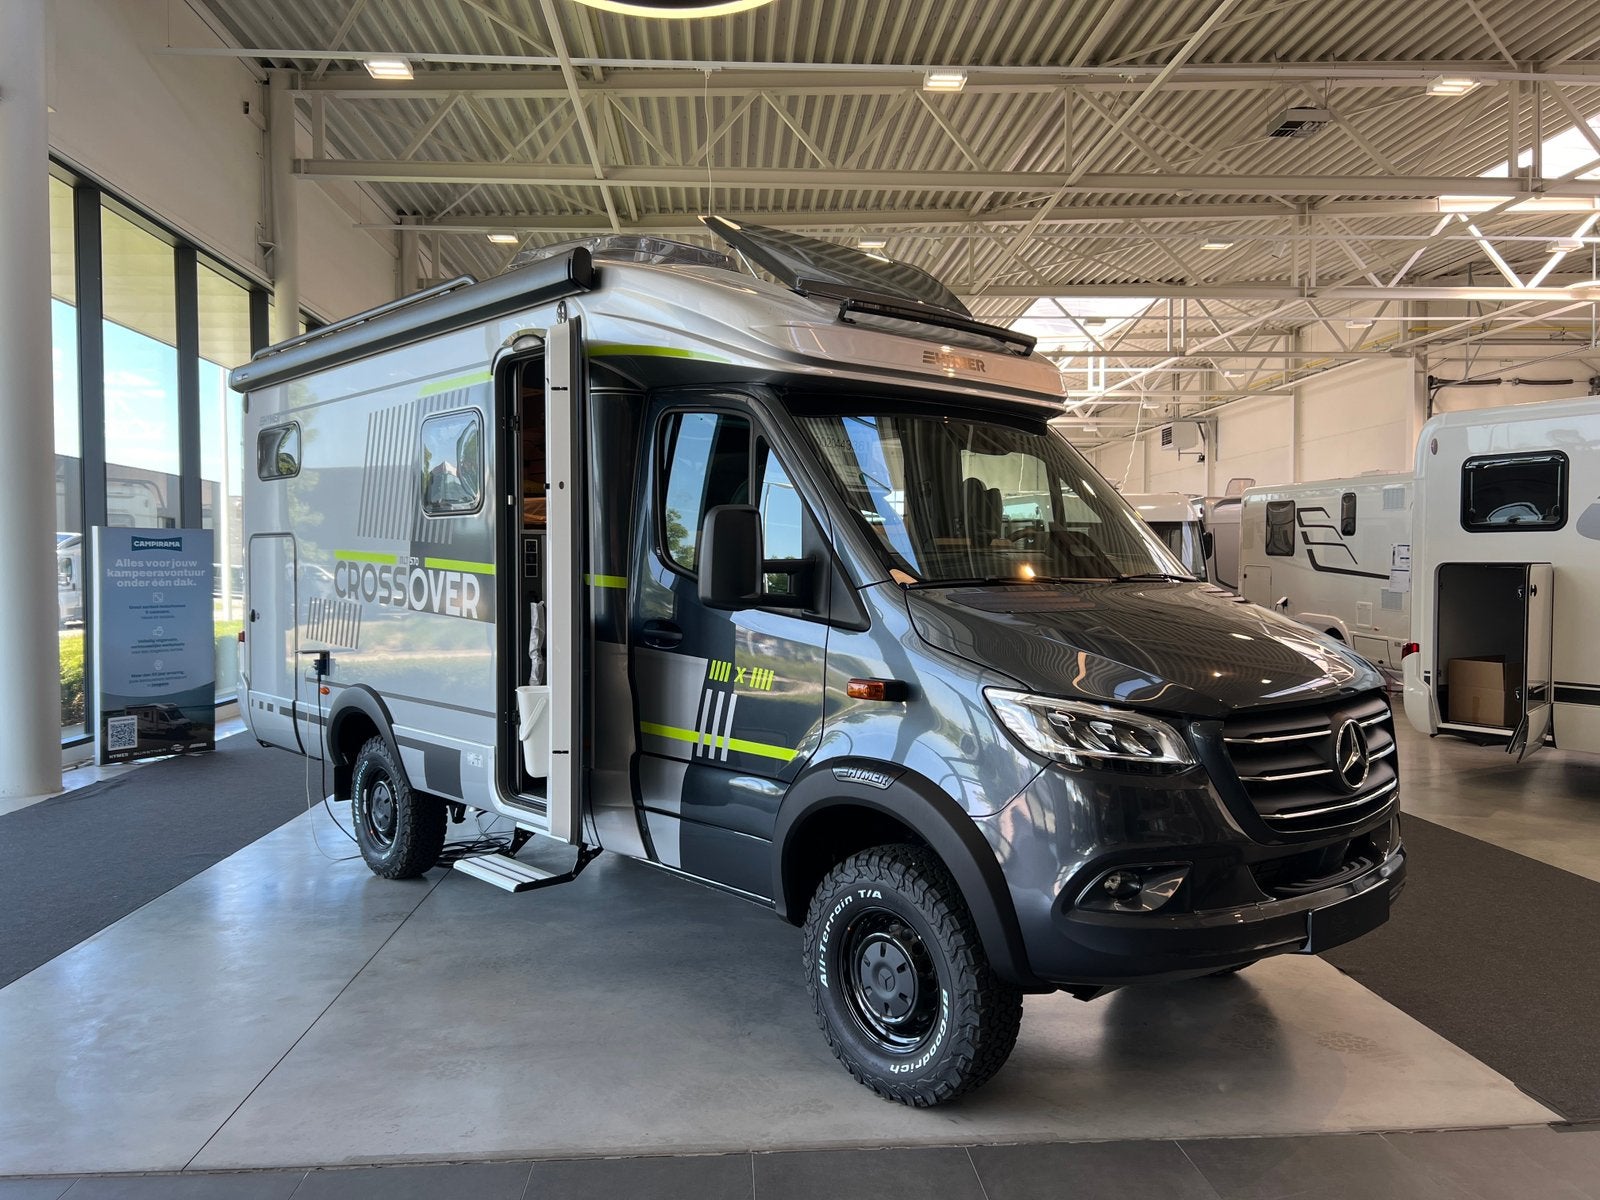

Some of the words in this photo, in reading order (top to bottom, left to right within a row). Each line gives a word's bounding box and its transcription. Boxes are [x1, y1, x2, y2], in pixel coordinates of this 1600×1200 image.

[133, 540, 181, 548] CAMPIRAMA
[115, 558, 144, 568] Alles
[171, 559, 198, 569] jouw
[409, 556, 419, 566] 570
[106, 569, 206, 579] kampeeravontuur
[116, 578, 151, 588] onder
[173, 577, 197, 587] dak.
[334, 560, 480, 619] CROSSOVER
[818, 895, 853, 989] All-Terrain
[858, 889, 882, 900] T/A
[889, 988, 949, 1075] BFGoodrich
